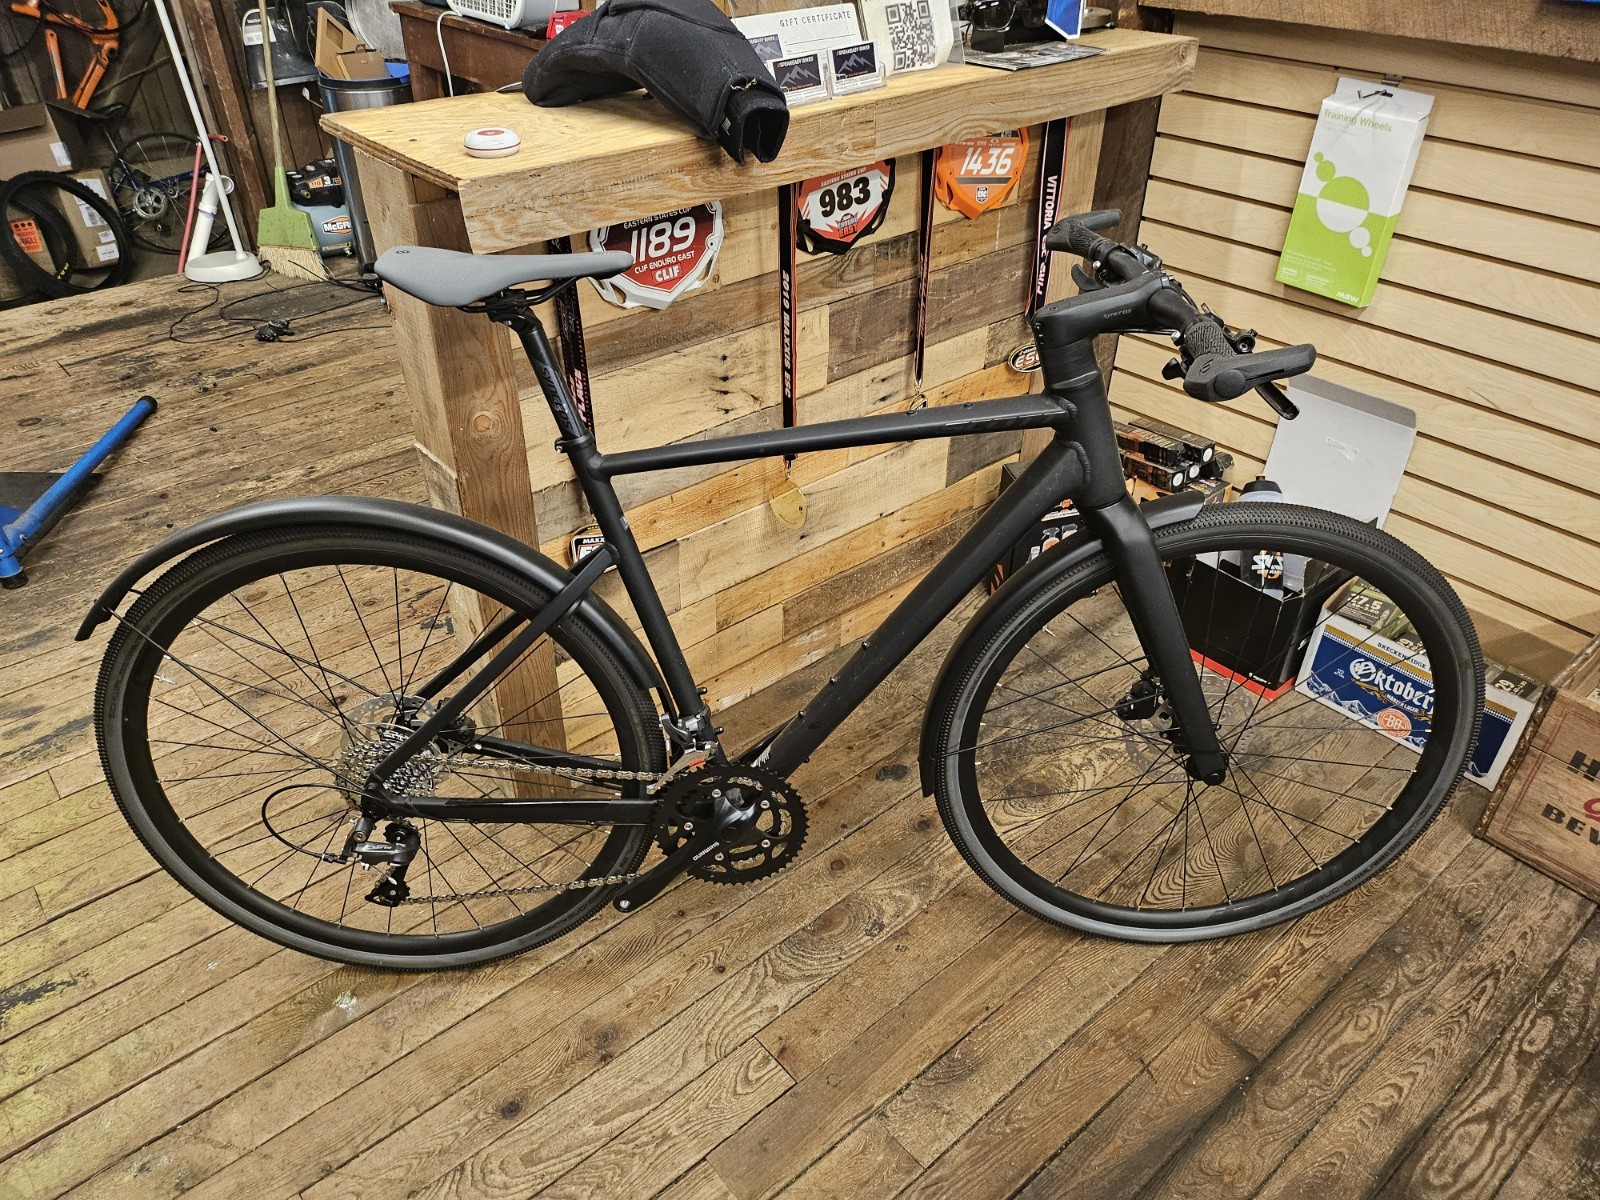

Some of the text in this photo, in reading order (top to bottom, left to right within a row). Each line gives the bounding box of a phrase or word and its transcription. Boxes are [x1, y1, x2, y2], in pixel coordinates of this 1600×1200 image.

[779, 10, 852, 28] GIFT CERTIFICATE
[1324, 108, 1357, 126] Training
[1359, 117, 1392, 133] Wheels
[960, 147, 1015, 175] 1436
[820, 176, 871, 218] 983
[1043, 175, 1058, 230] VITTORIA
[623, 206, 692, 229] EASTERN STATES CUP
[631, 216, 696, 265] 1189
[840, 223, 858, 238] EAST
[634, 250, 695, 275] CLIF ENDURO EAST
[655, 265, 680, 282] CLIF
[782, 270, 792, 399] 2019 MAXXIS ESC
[1347, 593, 1383, 610] 27.5
[1377, 642, 1427, 670] BRECKENRIDGE
[1495, 679, 1515, 692] 29
[692, 841, 720, 861] SHIMANO
